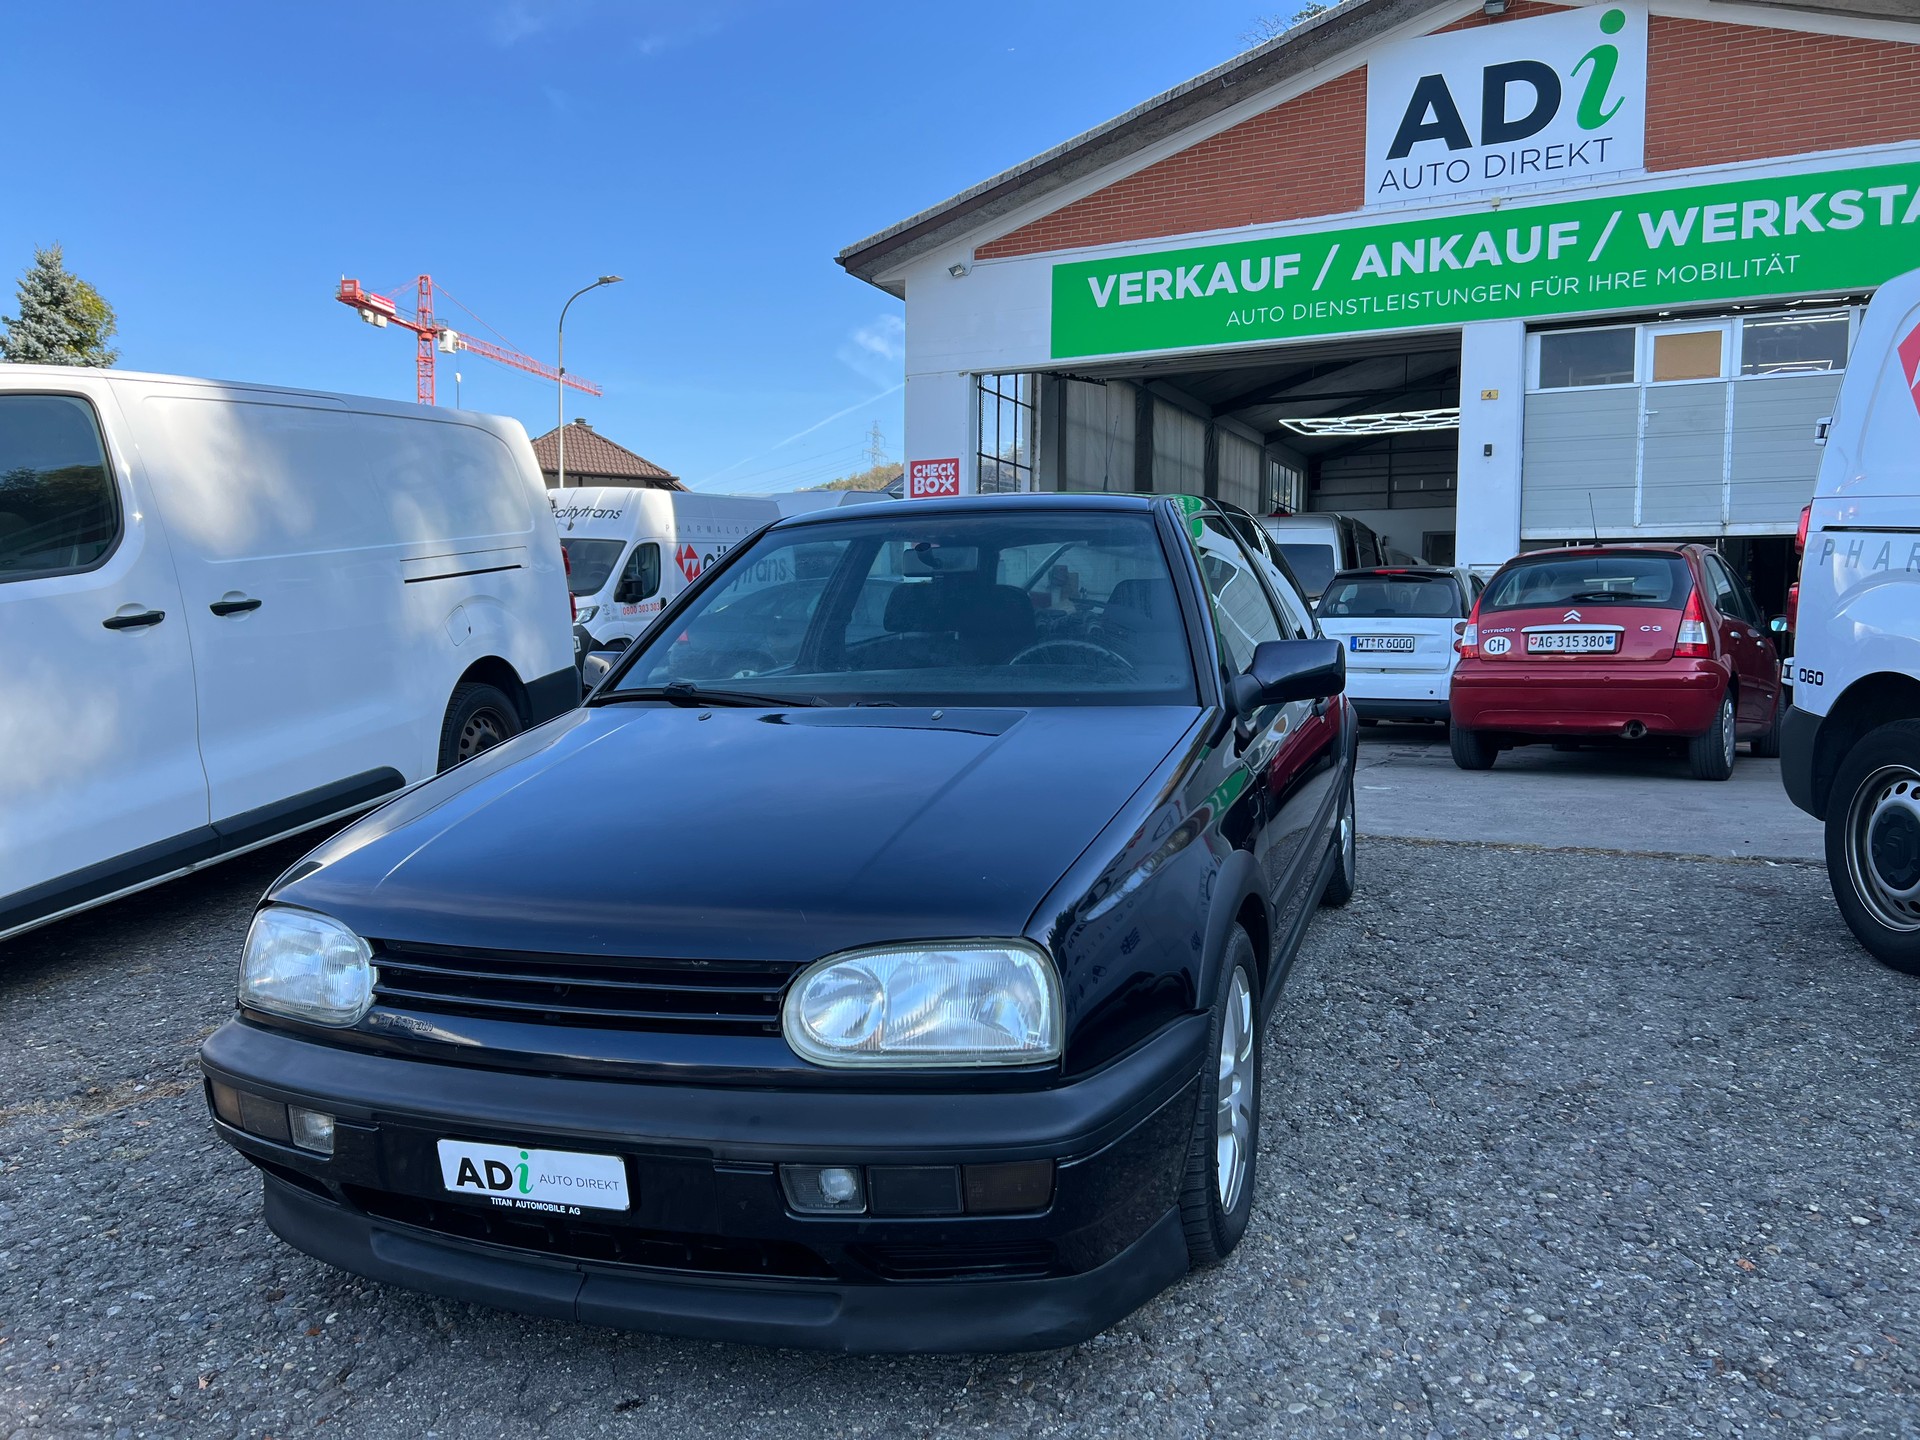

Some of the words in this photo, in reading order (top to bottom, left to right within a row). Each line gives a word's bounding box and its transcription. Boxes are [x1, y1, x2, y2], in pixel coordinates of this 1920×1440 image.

[1385, 8, 1626, 161] ADi
[1378, 158, 1470, 194] AUTO
[1484, 137, 1613, 179] DIREKT
[1087, 253, 1301, 308] VERKAUF
[1351, 221, 1580, 281] ANKAUF
[1226, 306, 1285, 327] AUTO
[1293, 282, 1521, 320] DIENSTLEISTUNGEN
[1530, 275, 1580, 299] FÜR
[1588, 269, 1648, 293] IHRE
[1656, 253, 1801, 286] MOBILITÄT
[913, 462, 956, 478] CHECK
[913, 475, 956, 495] BOX
[555, 505, 623, 520] citytrans
[622, 605, 638, 616] 0800
[1357, 638, 1370, 649] WT
[1386, 638, 1412, 649] 6000
[1488, 639, 1506, 653] CH
[1799, 667, 1824, 686] 060
[456, 1150, 534, 1194] ADi
[539, 1173, 573, 1187] AUTO
[576, 1177, 620, 1191] DIREKT
[490, 1197, 513, 1207] TITAN
[515, 1200, 566, 1213] AUTOMOBILE
[568, 1206, 581, 1215] AG
